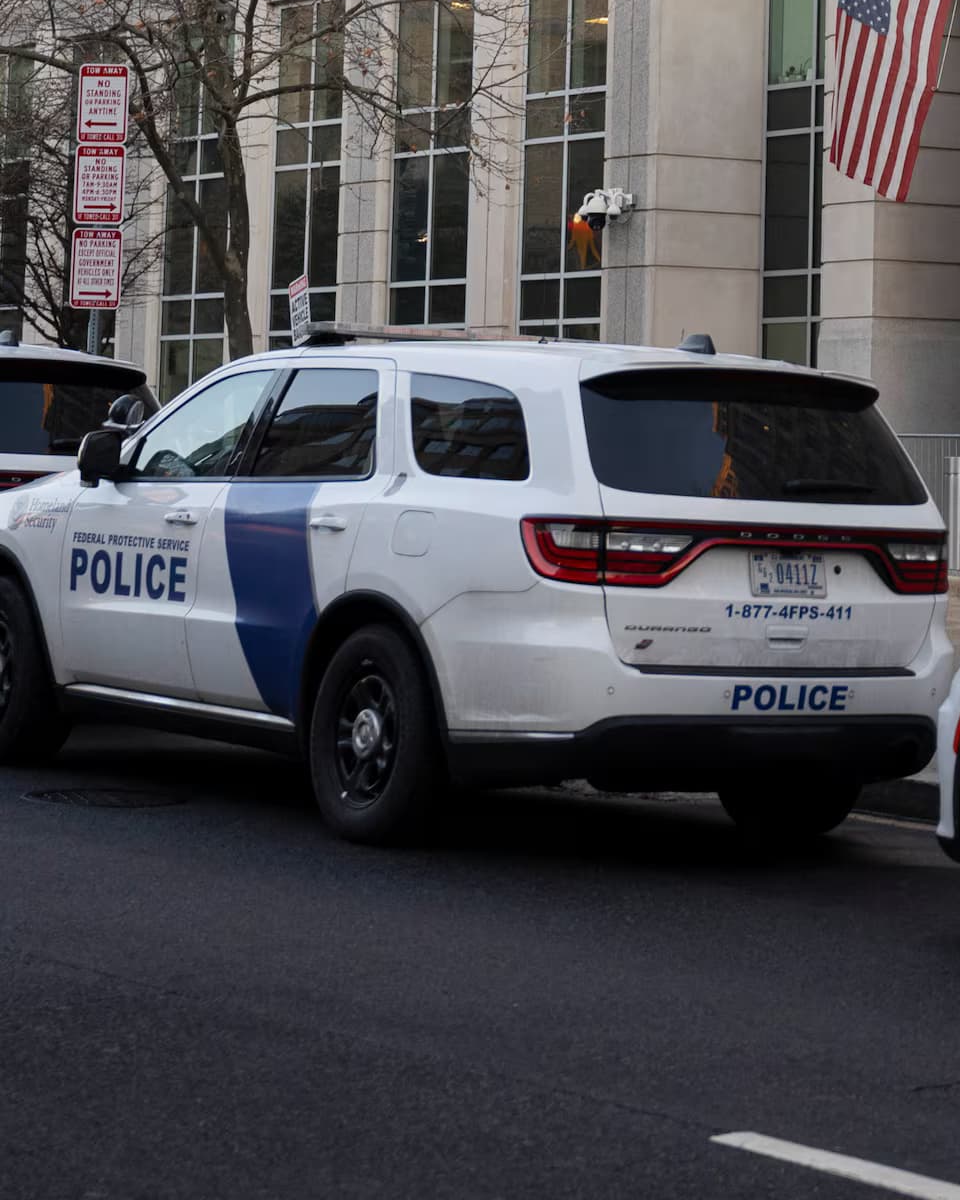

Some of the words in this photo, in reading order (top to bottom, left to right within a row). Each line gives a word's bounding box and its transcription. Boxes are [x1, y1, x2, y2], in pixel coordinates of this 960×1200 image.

[97, 80, 111, 88] NO
[86, 89, 121, 98] STANDING
[89, 107, 117, 115] ANYTIME
[99, 148, 118, 156] AWAY
[89, 240, 116, 248] PARKING
[79, 259, 114, 267] GOVERNMENT
[102, 268, 115, 277] ONLY
[73, 532, 106, 545] FEDERAL
[108, 534, 155, 549] PROTECTIVE
[157, 538, 190, 551] SERVICE
[70, 548, 188, 602] POLICE
[725, 603, 852, 620] 1-877-4FPS-411
[731, 684, 848, 711] POLICE
